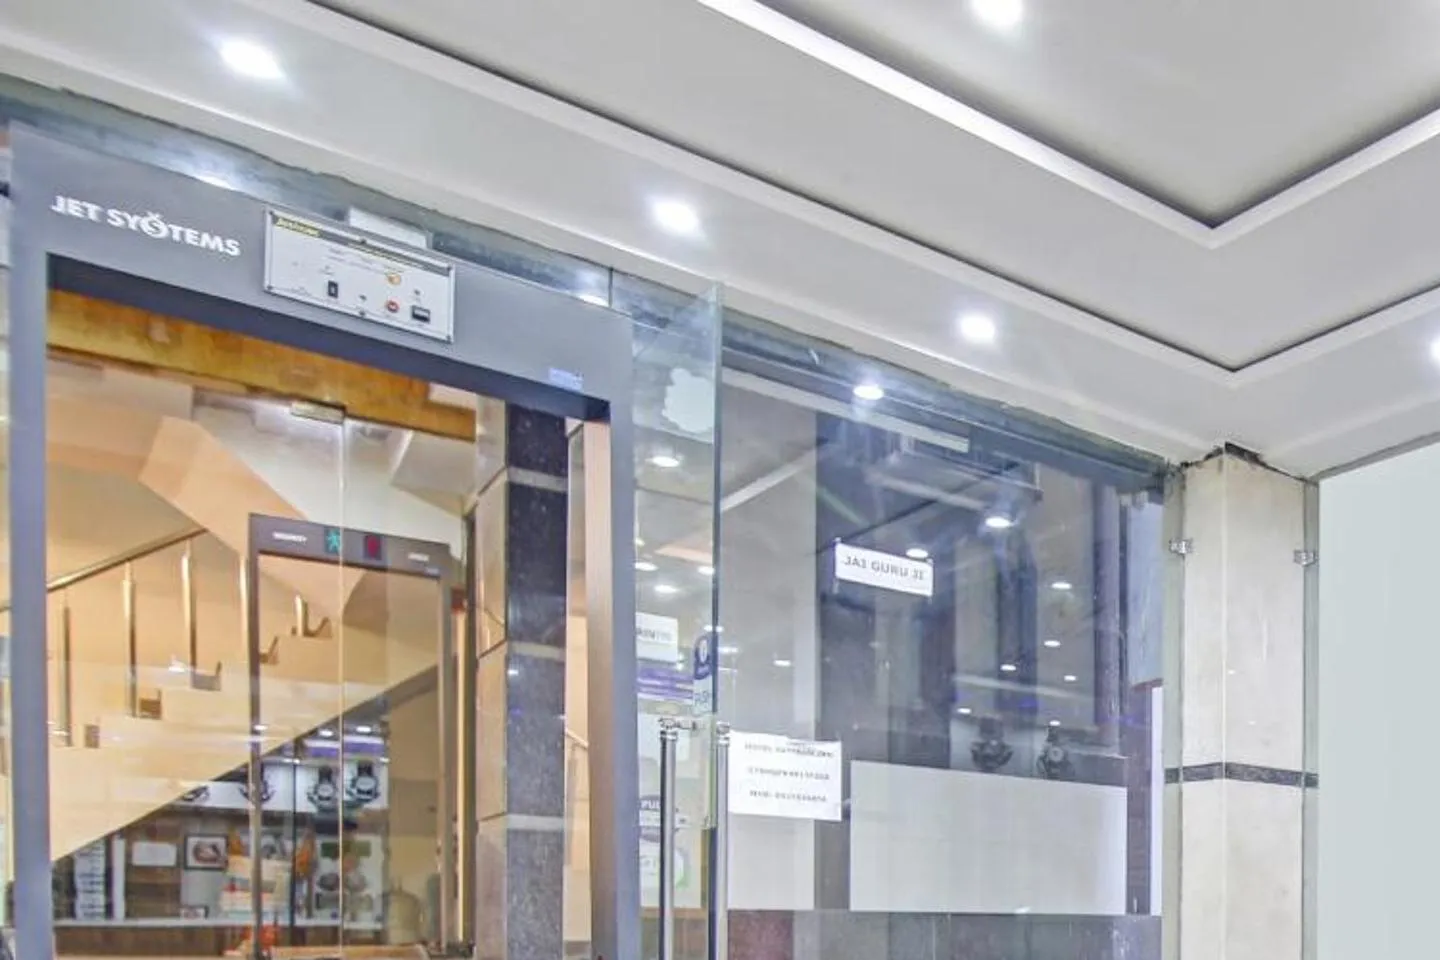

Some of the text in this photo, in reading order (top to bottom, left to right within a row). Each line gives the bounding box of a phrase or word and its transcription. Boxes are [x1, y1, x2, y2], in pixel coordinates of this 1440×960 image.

[51, 195, 101, 223] JET
[105, 208, 242, 257] SYSTEMS
[871, 559, 910, 577] GURU
